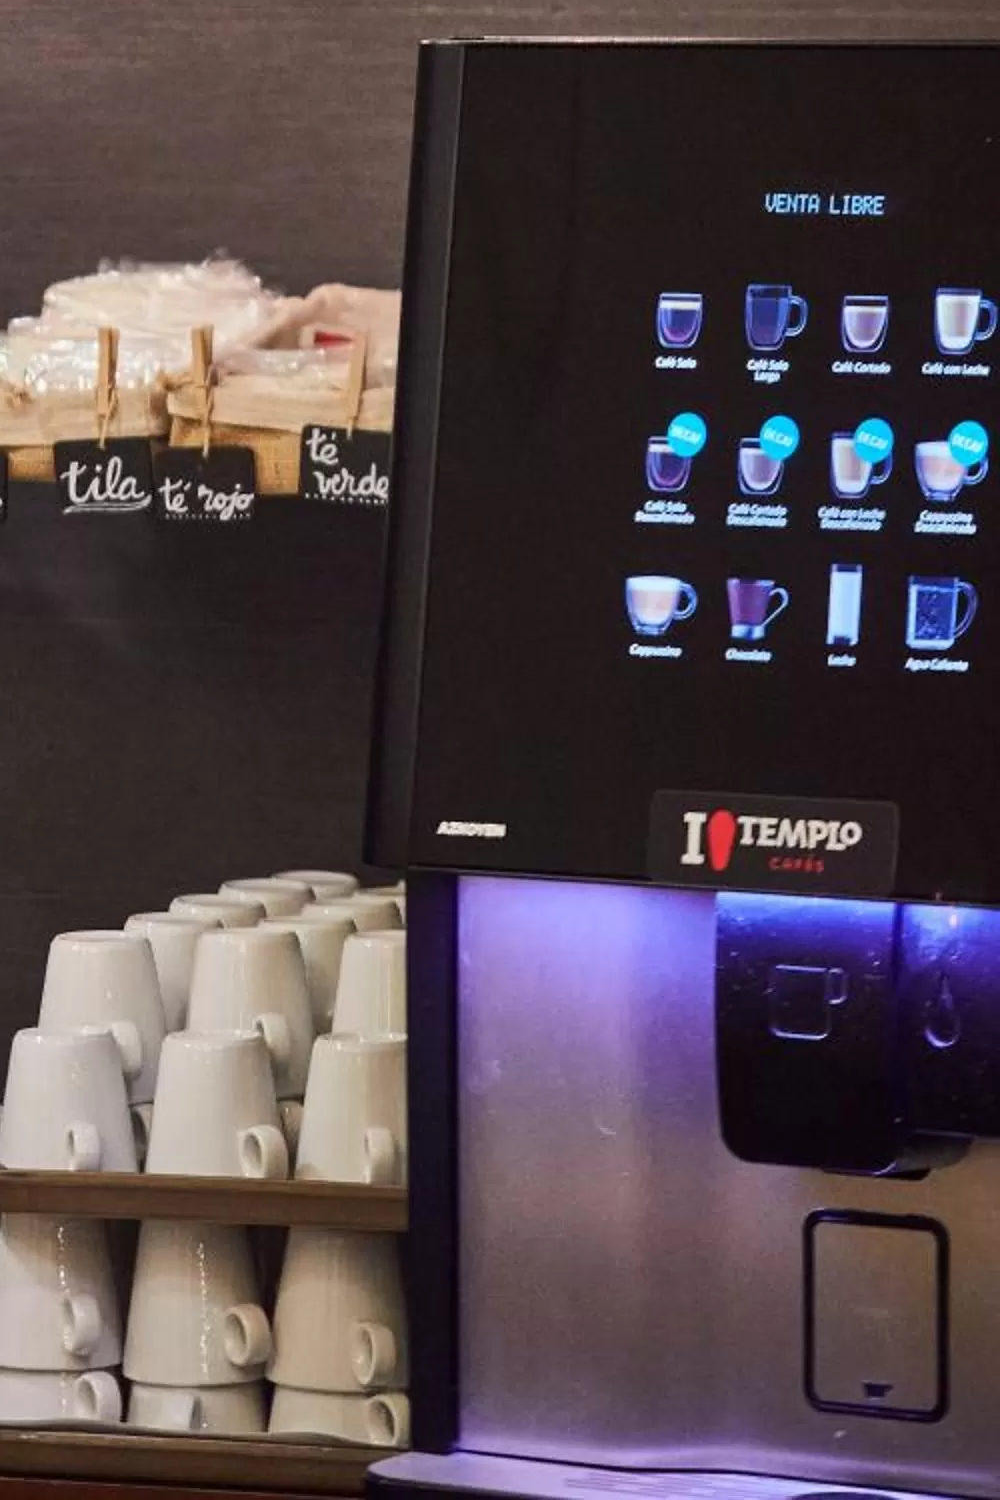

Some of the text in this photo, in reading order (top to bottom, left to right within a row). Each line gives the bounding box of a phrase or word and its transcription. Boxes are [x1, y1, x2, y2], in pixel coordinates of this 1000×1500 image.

[765, 193, 885, 215] VENTA LIBRE
[306, 428, 339, 465] té
[60, 455, 147, 504] tila
[158, 478, 254, 521] té rojo
[312, 462, 389, 498] verde
[681, 811, 863, 865] I TEMPLO
